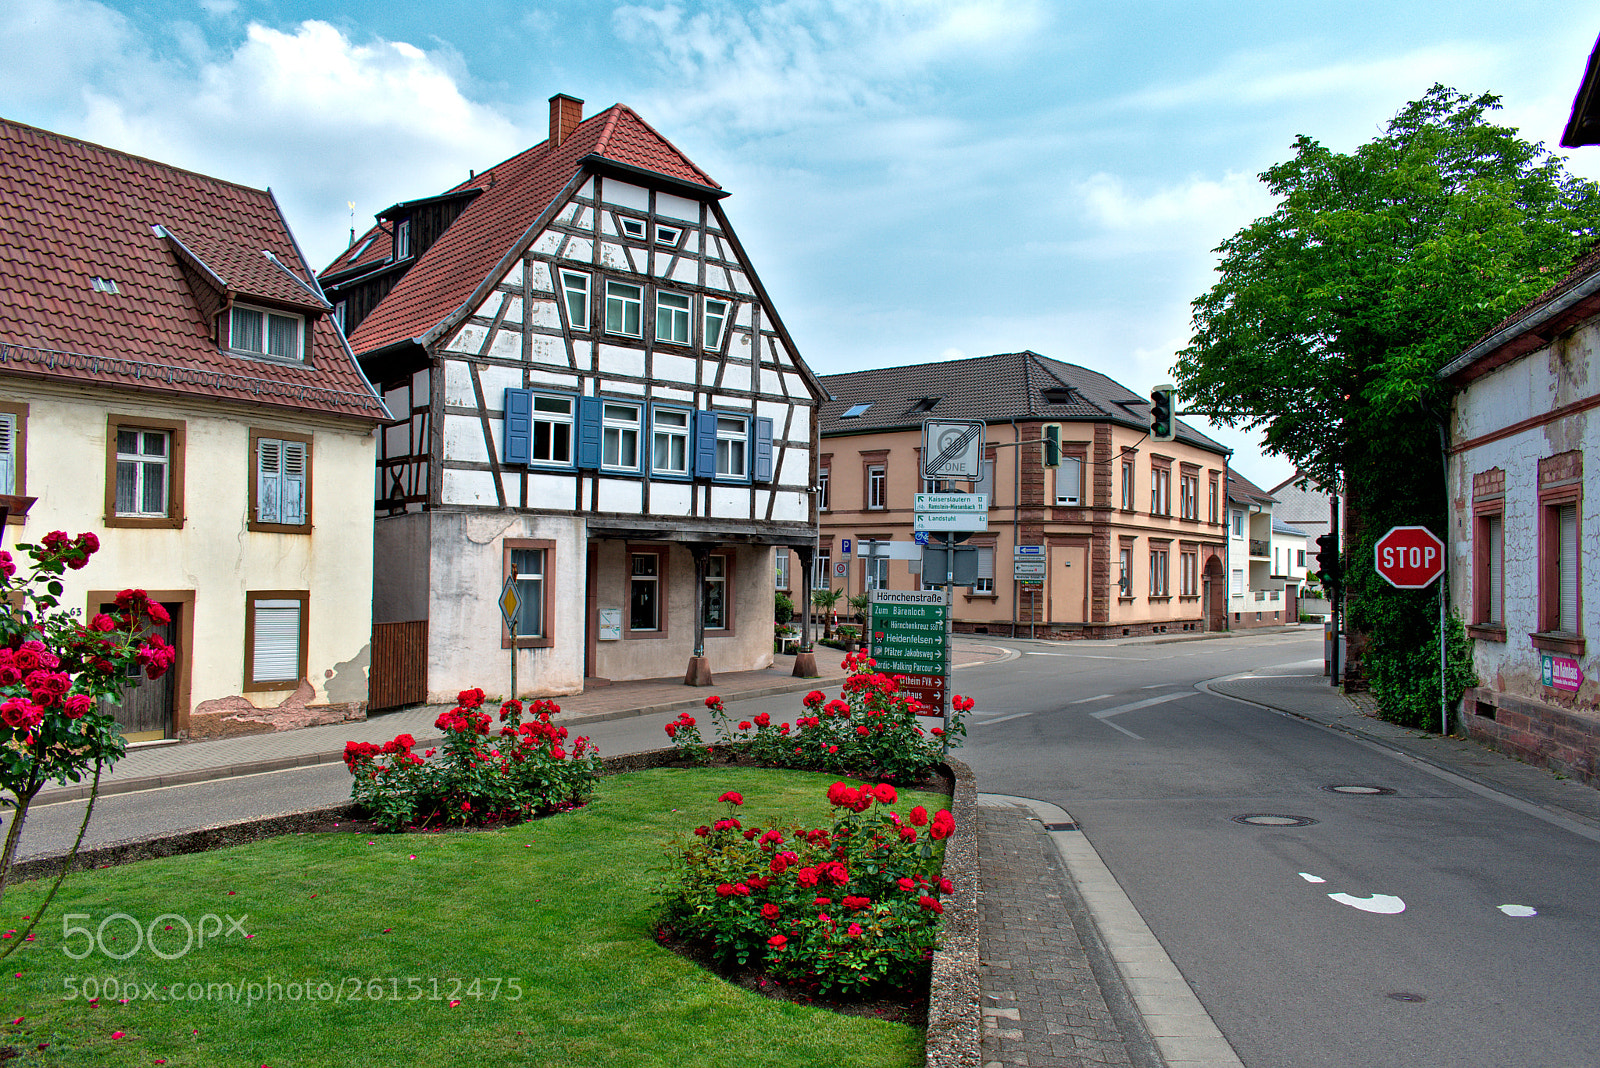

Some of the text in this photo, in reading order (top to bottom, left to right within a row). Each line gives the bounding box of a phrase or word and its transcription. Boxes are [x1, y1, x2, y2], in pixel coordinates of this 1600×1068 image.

[843, 540, 850, 552] P
[1383, 546, 1436, 569] STOP
[876, 592, 942, 603] Hörnchenstraße
[69, 607, 82, 617] 63
[874, 605, 926, 616] Zum Bärenloch
[890, 620, 929, 631] Hörnchenkreuz
[886, 633, 934, 644] Heidenfelsen
[884, 646, 934, 660] Pfälzer Jakobsweg
[913, 662, 933, 673] Parcour
